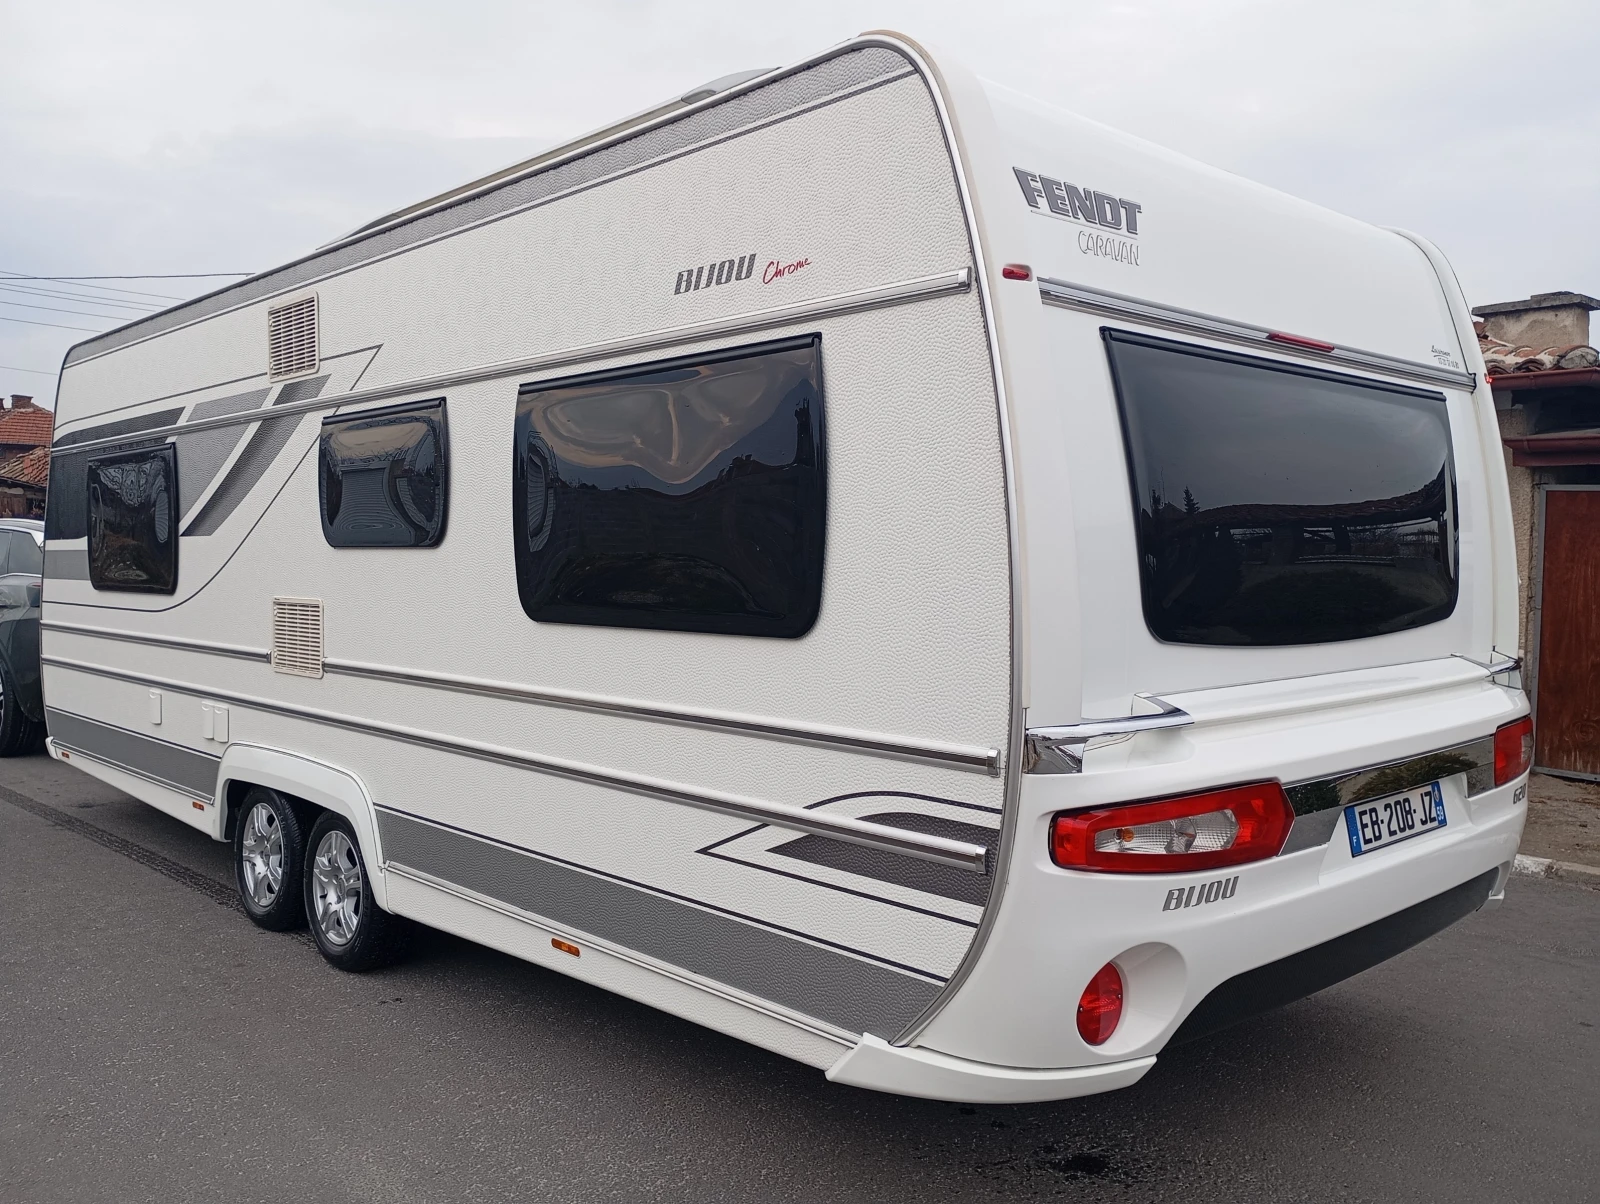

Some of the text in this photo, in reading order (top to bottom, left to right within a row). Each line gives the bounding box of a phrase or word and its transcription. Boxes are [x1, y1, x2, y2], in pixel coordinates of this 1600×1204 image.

[1012, 166, 1142, 235] FENDT
[1078, 230, 1139, 266] CARAVAN
[674, 253, 812, 295] BIJOU Chrome
[1352, 836, 1357, 847] F
[1162, 875, 1239, 912] BIJOU
